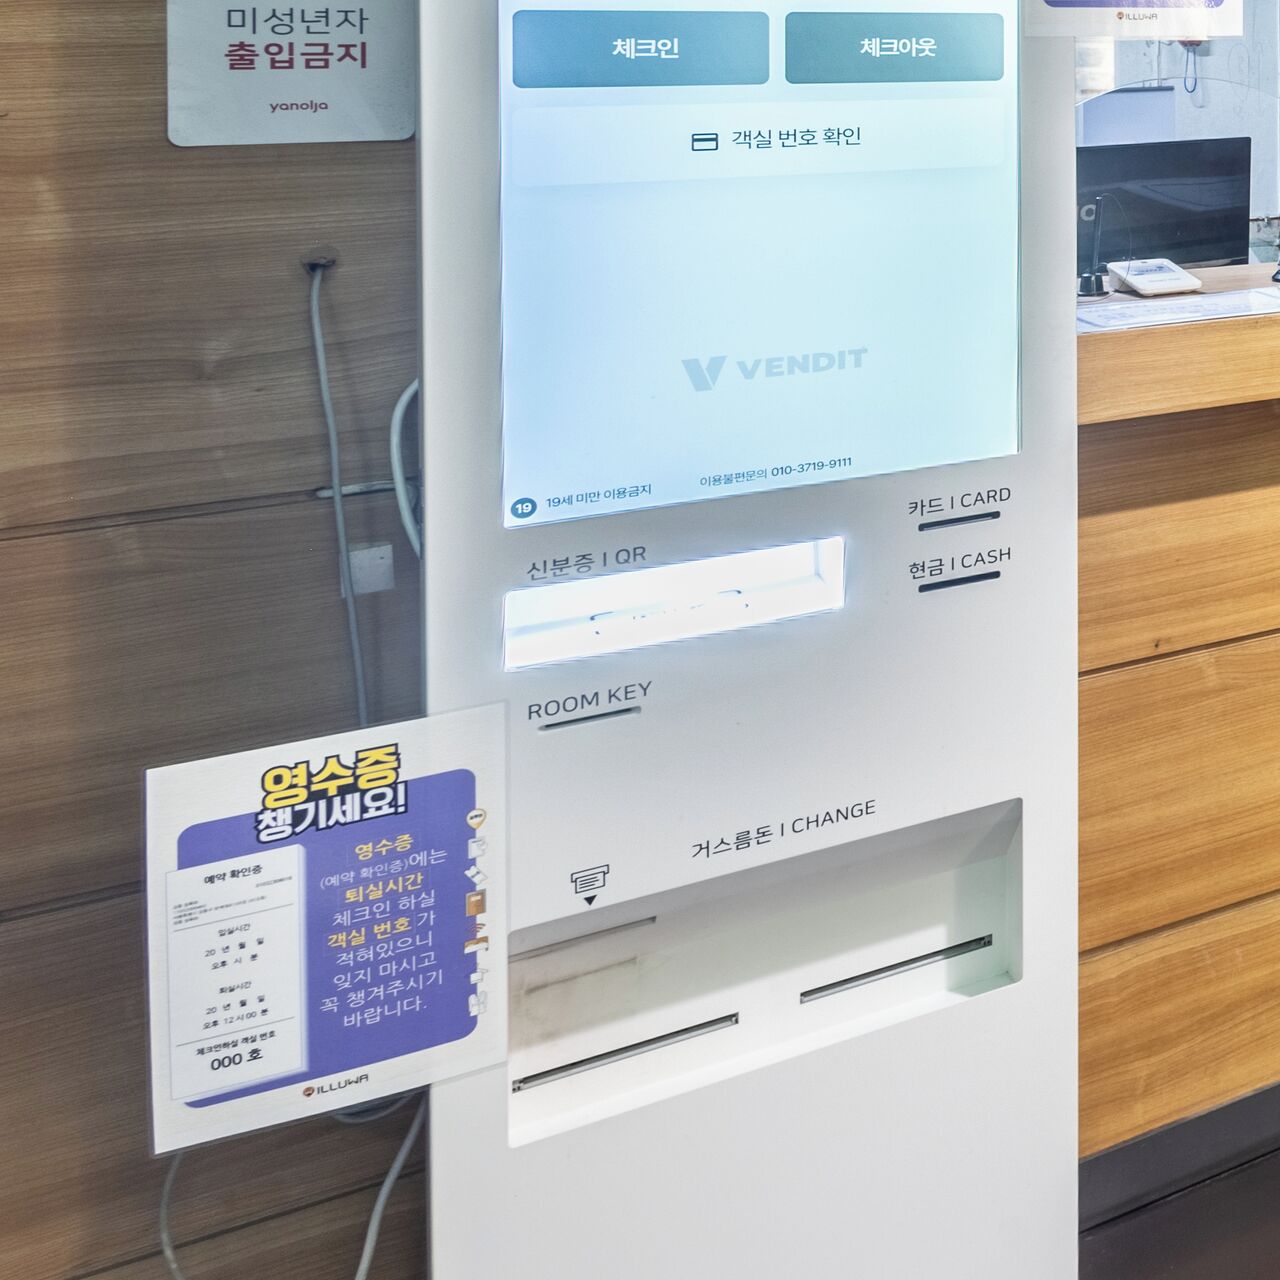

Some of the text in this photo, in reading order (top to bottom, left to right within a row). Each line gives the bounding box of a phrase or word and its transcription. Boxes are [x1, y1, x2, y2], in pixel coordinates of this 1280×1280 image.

[227, 7, 369, 35] 미성년자
[1125, 11, 1158, 21] ILLUWA
[224, 41, 368, 71] 출입금지
[612, 37, 680, 60] 체크인
[860, 37, 937, 59] 체크아웃
[269, 99, 329, 114] yanolja
[732, 126, 861, 150] 객실 번호 확인
[736, 347, 868, 380] VENDIT
[699, 456, 853, 487] 이용불편문의 010-3719-9111
[515, 483, 652, 516] 19 19세 미만 이용금지
[908, 487, 1011, 516] 카드 CARD
[526, 545, 647, 581] 신분증 QR
[909, 547, 1011, 580] 현금 CASH
[528, 681, 653, 720] ROOM KEY
[262, 744, 401, 810] 영수증
[256, 781, 408, 843] 챙기세요!
[692, 799, 876, 859] 거스름돈 CHANGE
[354, 834, 413, 861] 영수증
[320, 871, 355, 890] (예약
[345, 872, 424, 903] 퇴실시간
[332, 889, 435, 927] 체크인 하실
[328, 911, 436, 949] 객실 번호 가
[336, 931, 432, 966] 적혀있으니
[333, 951, 437, 991] 잊지 마시고
[319, 969, 443, 1013] 꼭 챙겨주시기
[343, 995, 428, 1028] 바랍니다.
[210, 1048, 263, 1070] 000 호
[317, 1073, 369, 1095] ILLUWA
